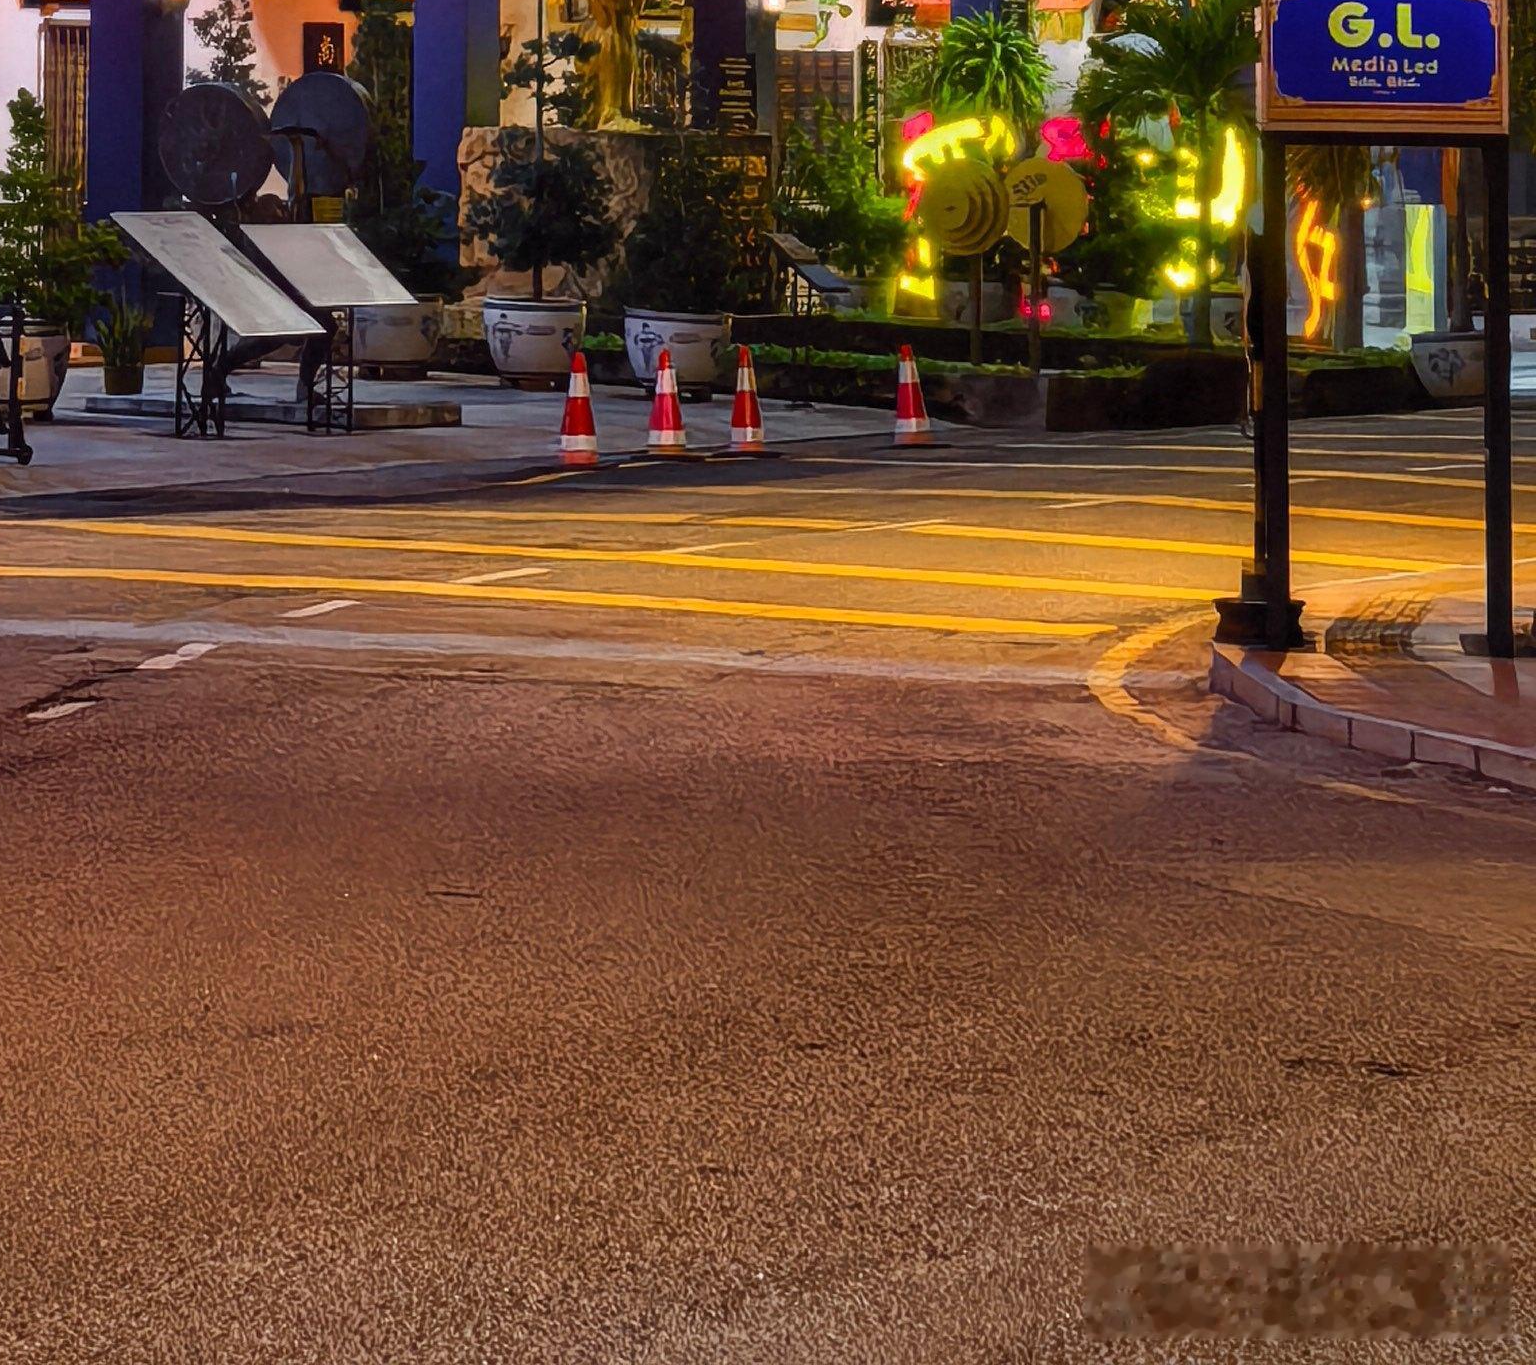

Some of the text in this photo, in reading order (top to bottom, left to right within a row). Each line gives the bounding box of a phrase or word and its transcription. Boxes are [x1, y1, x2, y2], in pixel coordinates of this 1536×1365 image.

[1327, 1, 1441, 50] G.L.
[1331, 54, 1439, 75] Media Led
